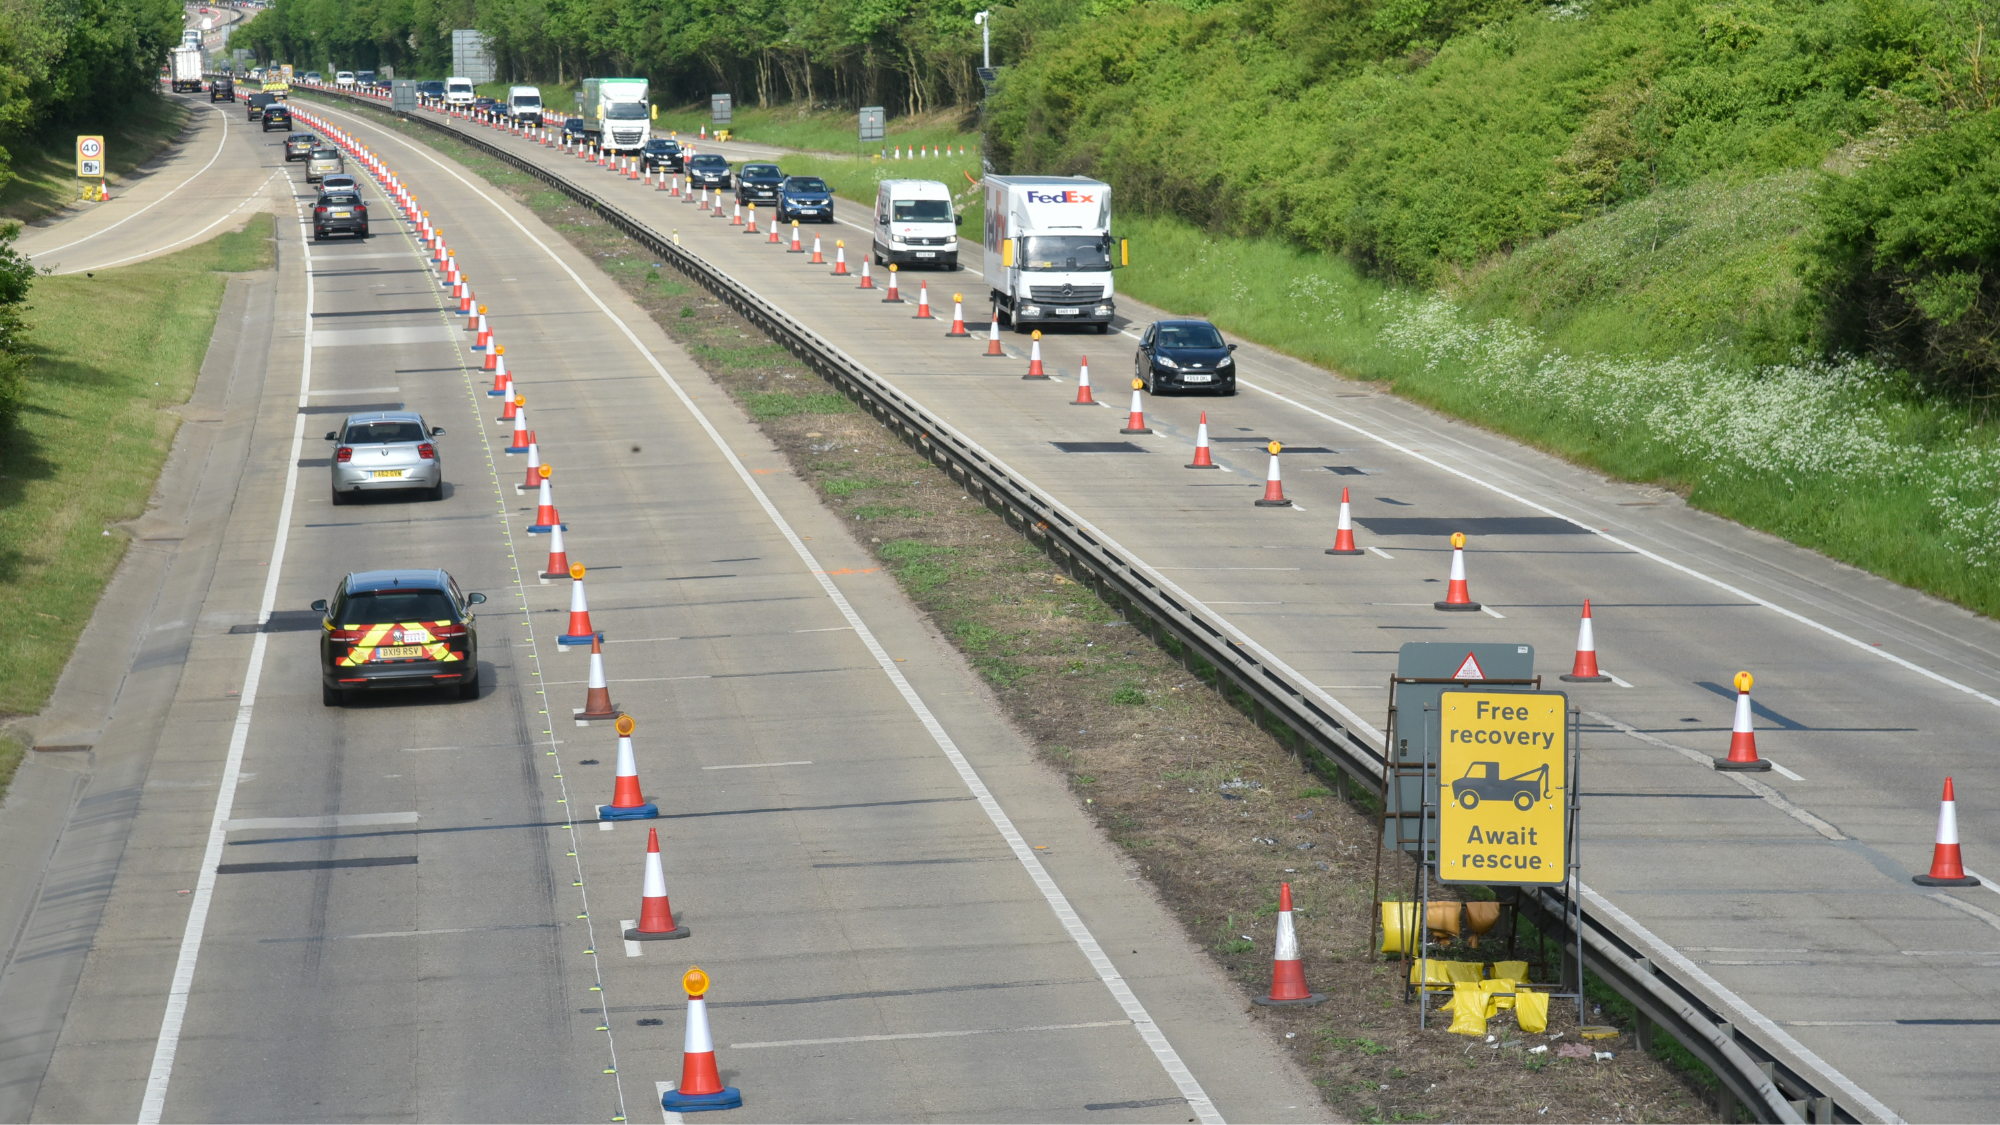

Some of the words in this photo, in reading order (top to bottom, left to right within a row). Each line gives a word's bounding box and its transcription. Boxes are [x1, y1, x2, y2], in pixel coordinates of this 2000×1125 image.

[83, 143, 98, 152] 40
[1027, 190, 1095, 204] FedEx
[383, 648, 401, 656] BX19
[403, 647, 419, 655] RSV
[1477, 701, 1529, 720] Free
[1450, 729, 1555, 749] recovery
[1467, 825, 1538, 846] Await
[1462, 854, 1542, 869] rescue
